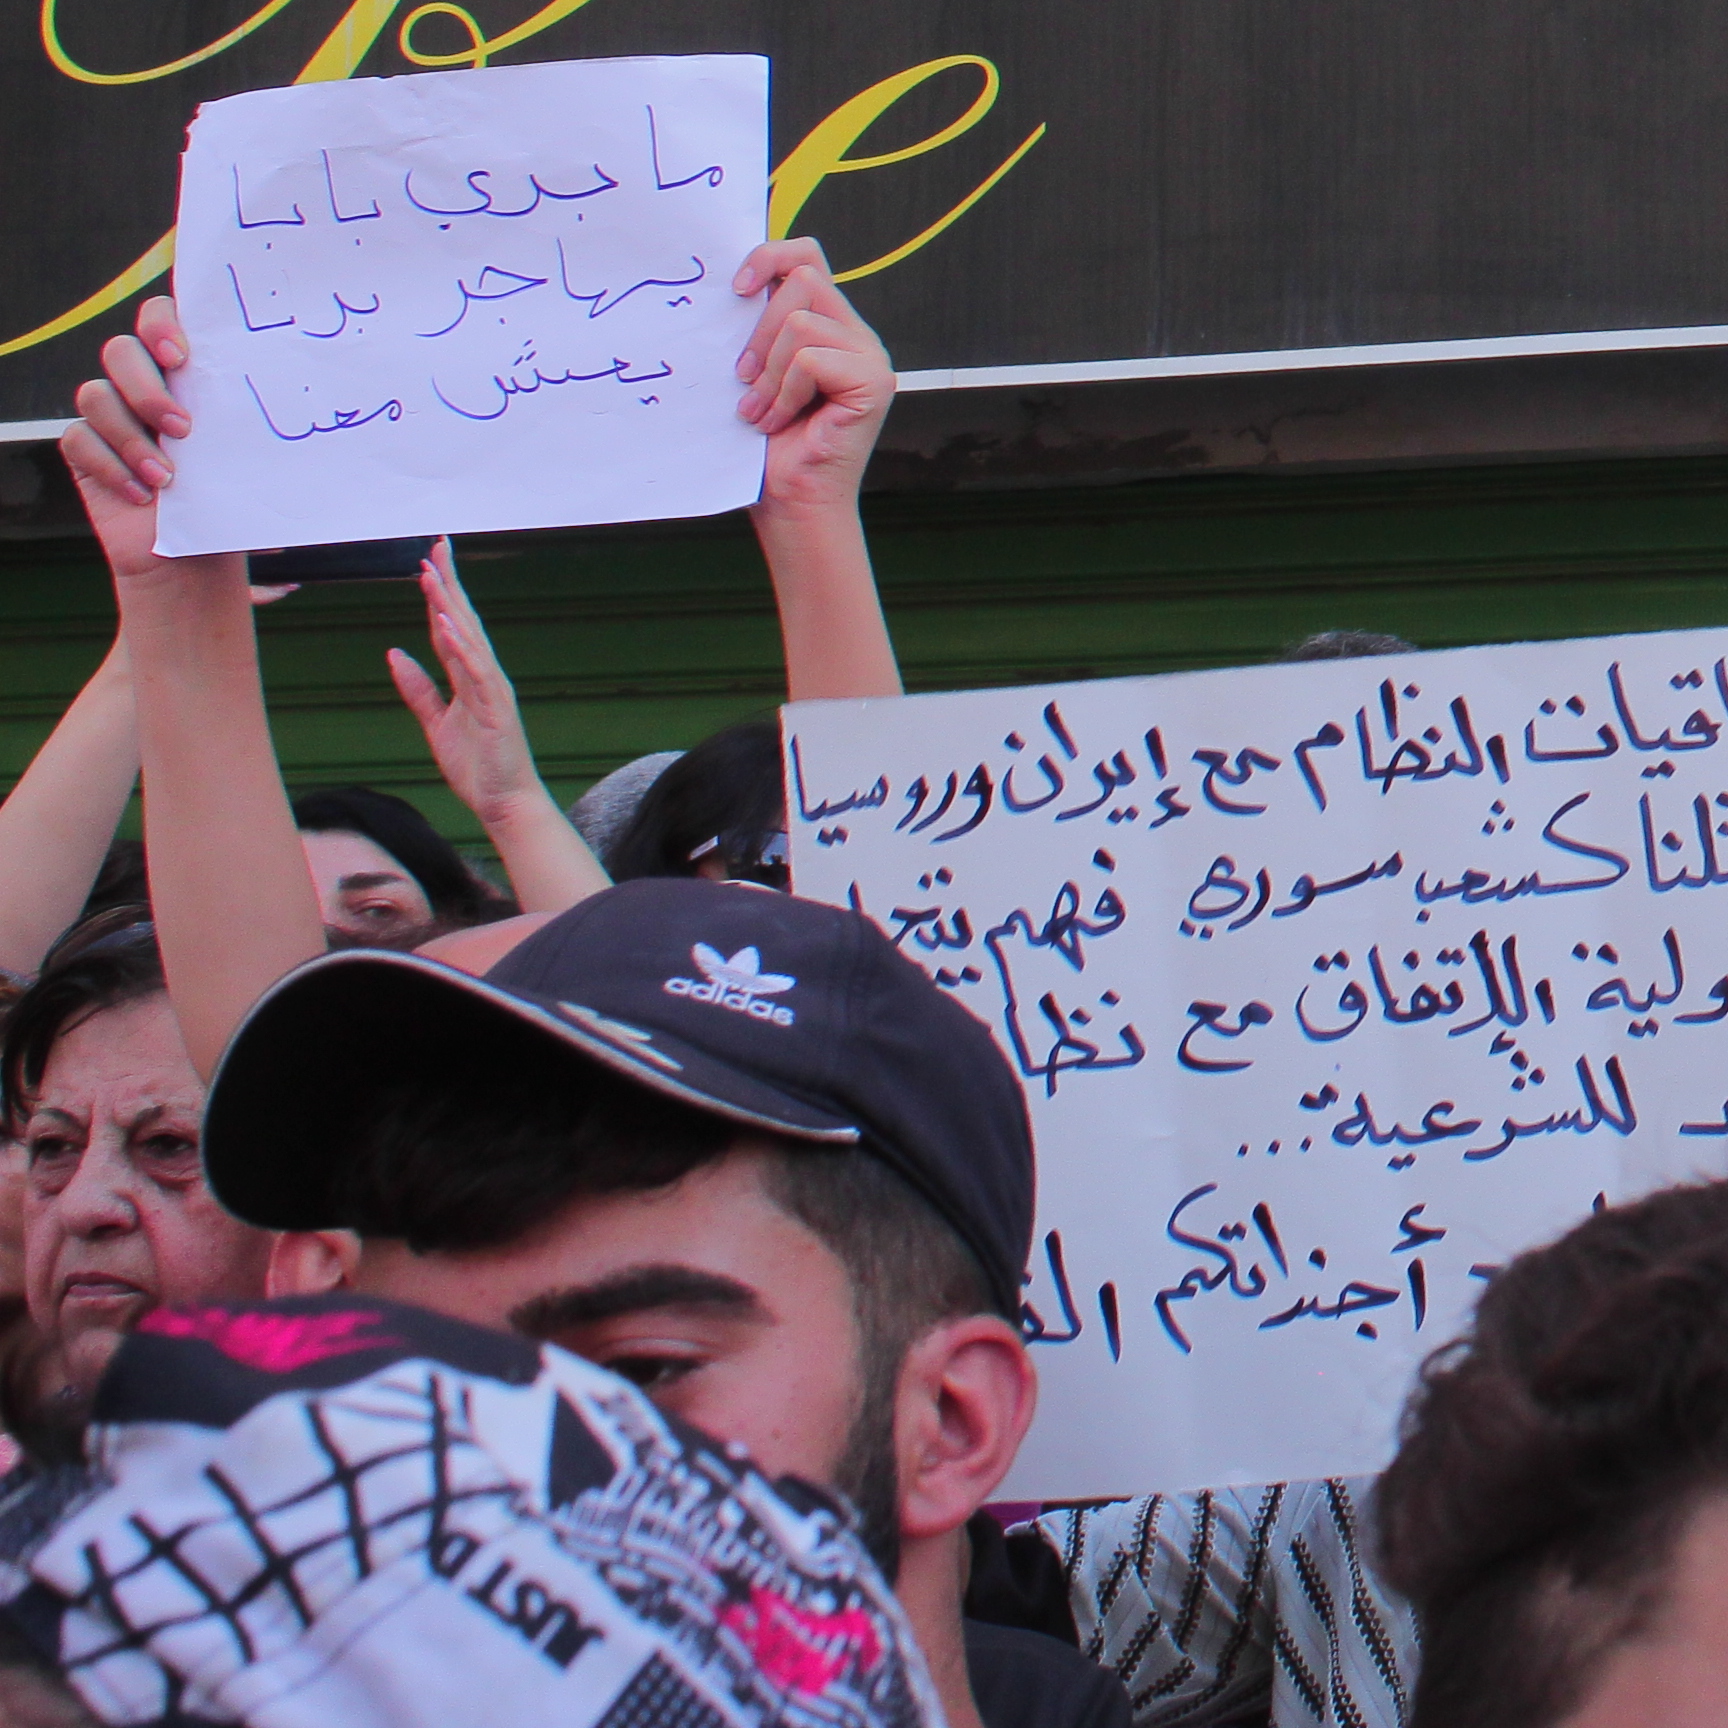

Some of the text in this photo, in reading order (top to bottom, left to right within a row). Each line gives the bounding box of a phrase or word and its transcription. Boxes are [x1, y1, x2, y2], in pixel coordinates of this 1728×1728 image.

[646, 103, 724, 190] ما
[232, 148, 382, 251] بابا
[414, 236, 706, 338] يهاجر
[244, 373, 403, 442] معنا
[1190, 747, 1282, 816] مع
[1293, 676, 1512, 814] النظام
[661, 975, 796, 1027] adidas
[1002, 988, 1147, 1101] نظا
[1177, 999, 1275, 1073] مع
